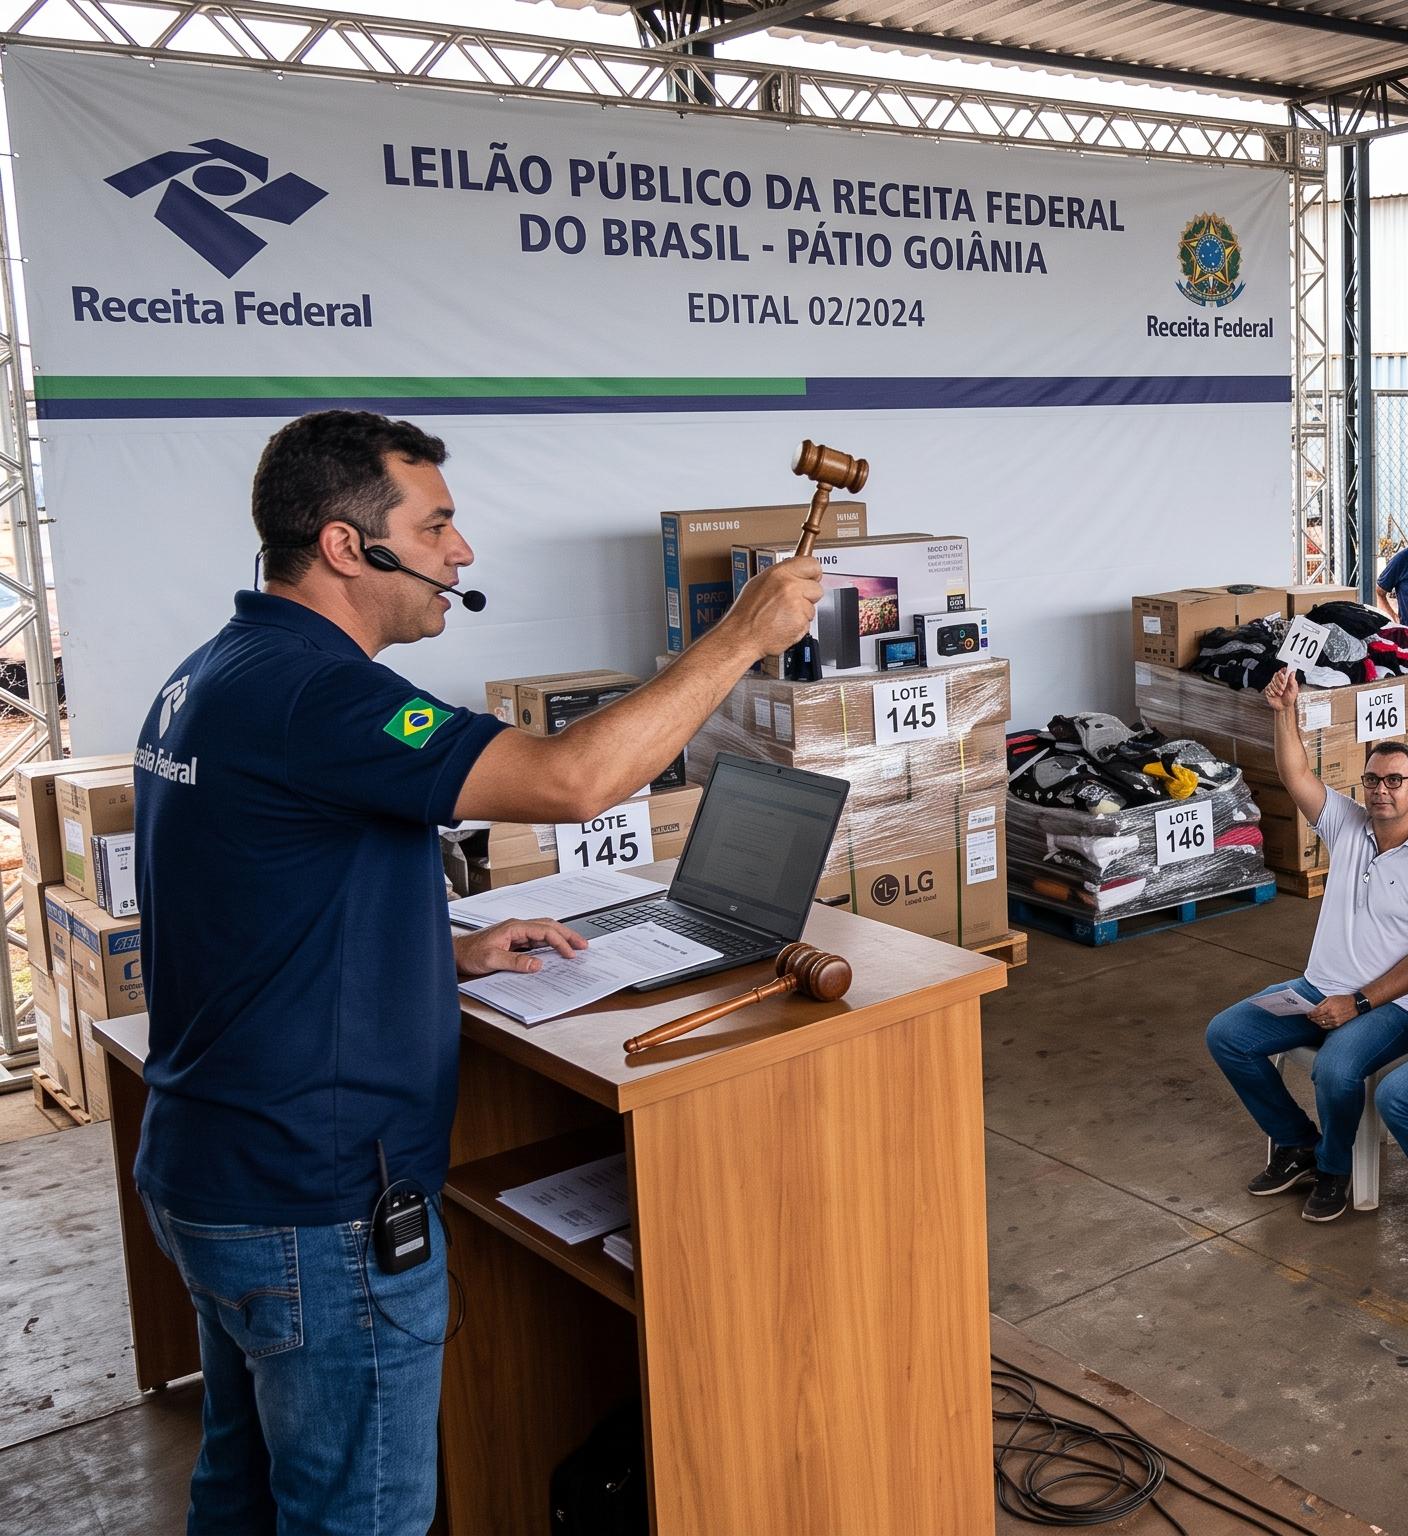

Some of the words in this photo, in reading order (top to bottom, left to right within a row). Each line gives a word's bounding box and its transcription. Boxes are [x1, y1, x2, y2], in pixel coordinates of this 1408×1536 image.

[382, 142, 552, 195] LEILÃO
[568, 151, 752, 208] PÚBLICO
[765, 173, 822, 213] DA
[832, 178, 977, 223] RECEITA
[986, 190, 1125, 232] FEDERAL
[519, 213, 587, 255] DO
[602, 217, 750, 262] BRASIL
[762, 244, 774, 252] -
[787, 220, 892, 268] PÁTIO
[903, 230, 1048, 275] GOIÂNIA
[71, 285, 225, 325] Receita
[234, 291, 373, 328] Federal
[687, 292, 799, 325] EDITAL
[808, 296, 926, 328] 02/2024
[1146, 314, 1210, 338] Receita
[1214, 316, 1274, 338] Federal
[688, 520, 740, 533] SAMSUNG
[1289, 632, 1320, 660] 110
[891, 686, 928, 702] LOTE
[1369, 693, 1393, 707] LOTE
[886, 702, 936, 733] 145
[1365, 707, 1398, 732] 146
[134, 743, 156, 772] ceita
[153, 748, 198, 786] Federal
[581, 813, 628, 835] LOTE
[1169, 809, 1199, 826] LOTE
[574, 831, 639, 868] 145
[1166, 823, 1205, 853] 146
[904, 870, 934, 896] LG
